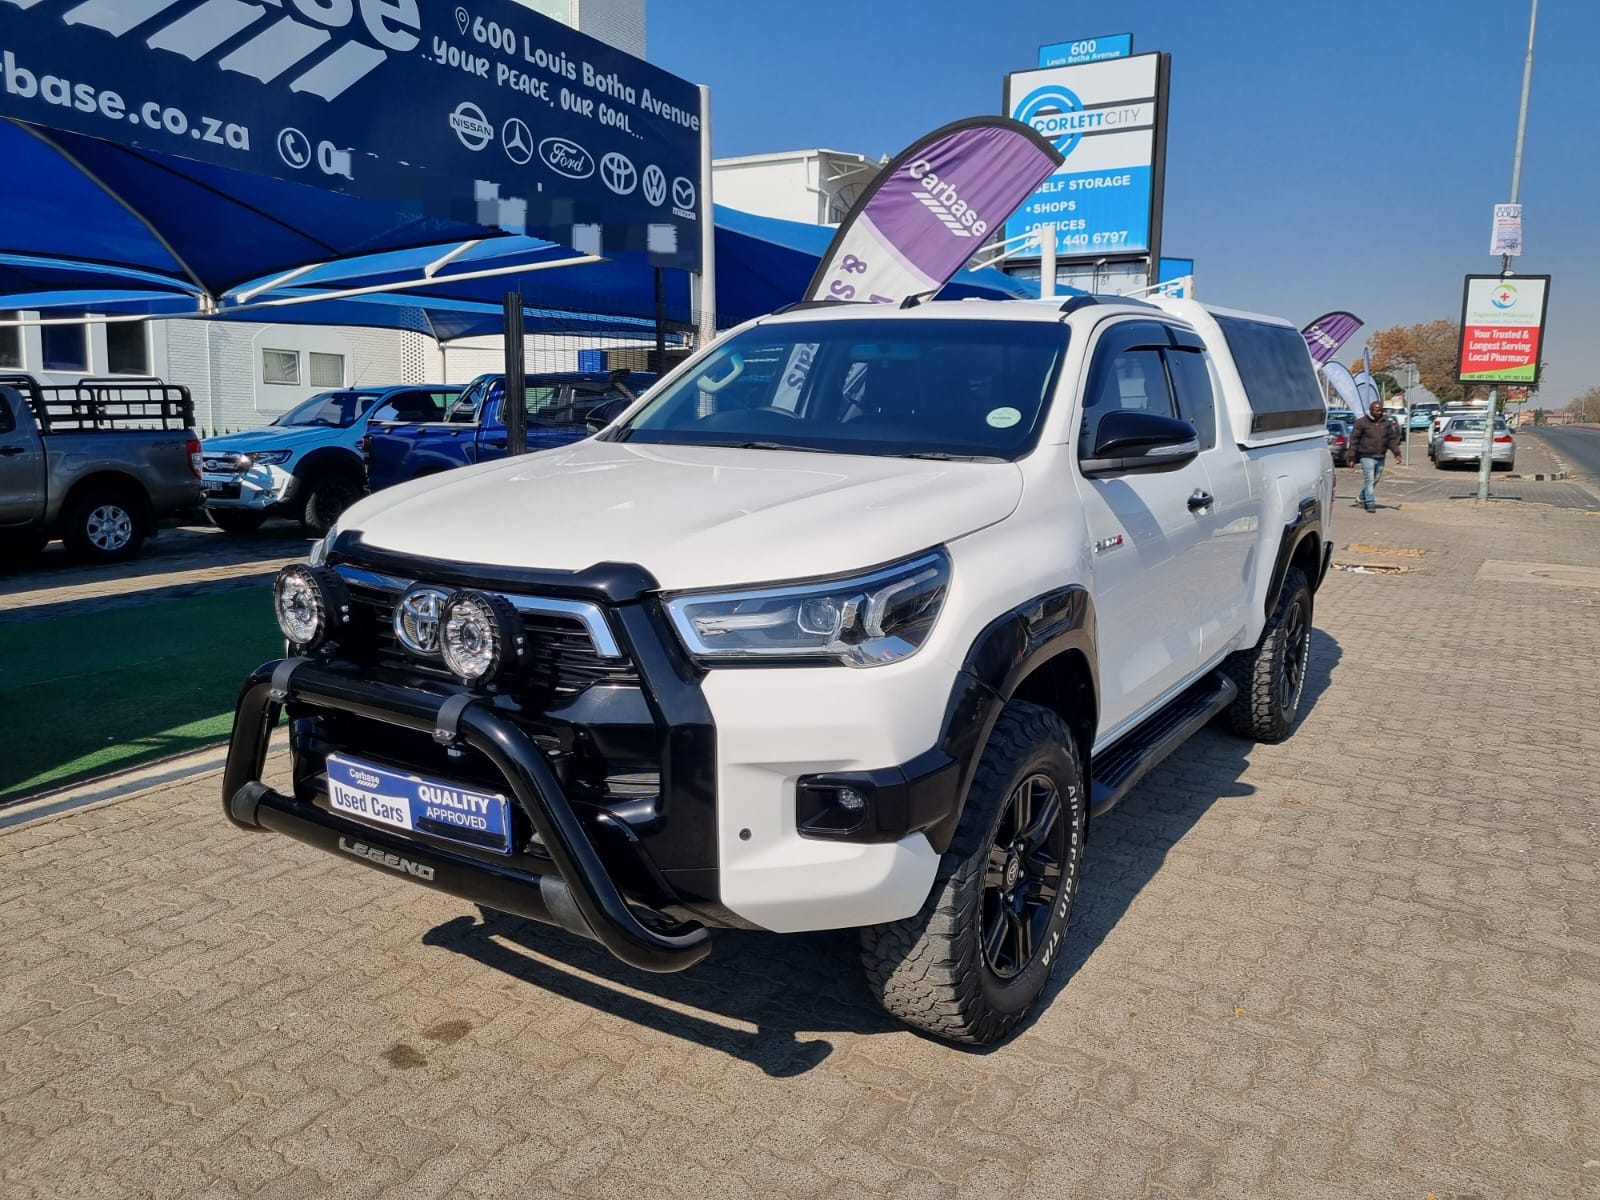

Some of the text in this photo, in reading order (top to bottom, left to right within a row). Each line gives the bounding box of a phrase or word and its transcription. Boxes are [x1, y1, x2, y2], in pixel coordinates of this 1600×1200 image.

[1071, 40, 1097, 55] 600
[1046, 50, 1121, 66] Louis Botha Avenue
[473, 16, 516, 55] 600
[524, 36, 577, 81] Louis
[583, 61, 636, 105] Botha
[640, 88, 700, 132] Avenue
[560, 88, 594, 118] OUR
[452, 117, 492, 137] NISSAN
[549, 142, 585, 173] Ford
[1069, 175, 1131, 191] STORAGE
[909, 159, 988, 237] Carbase
[1033, 200, 1076, 213] SHOPS
[1063, 233, 1088, 246] 440
[1093, 231, 1128, 244] 6797
[1474, 329, 1529, 339] Your Trusted &
[1469, 341, 1531, 353] Longest Serving
[1468, 352, 1530, 364] Local Pharmacy
[349, 767, 380, 786] Carbase
[334, 785, 404, 823] Used Cars
[418, 785, 490, 814] QUALITY
[426, 806, 487, 830] APPROVED
[338, 835, 436, 881] LEGEND
[1041, 784, 1079, 967] All-Terrain T/A
